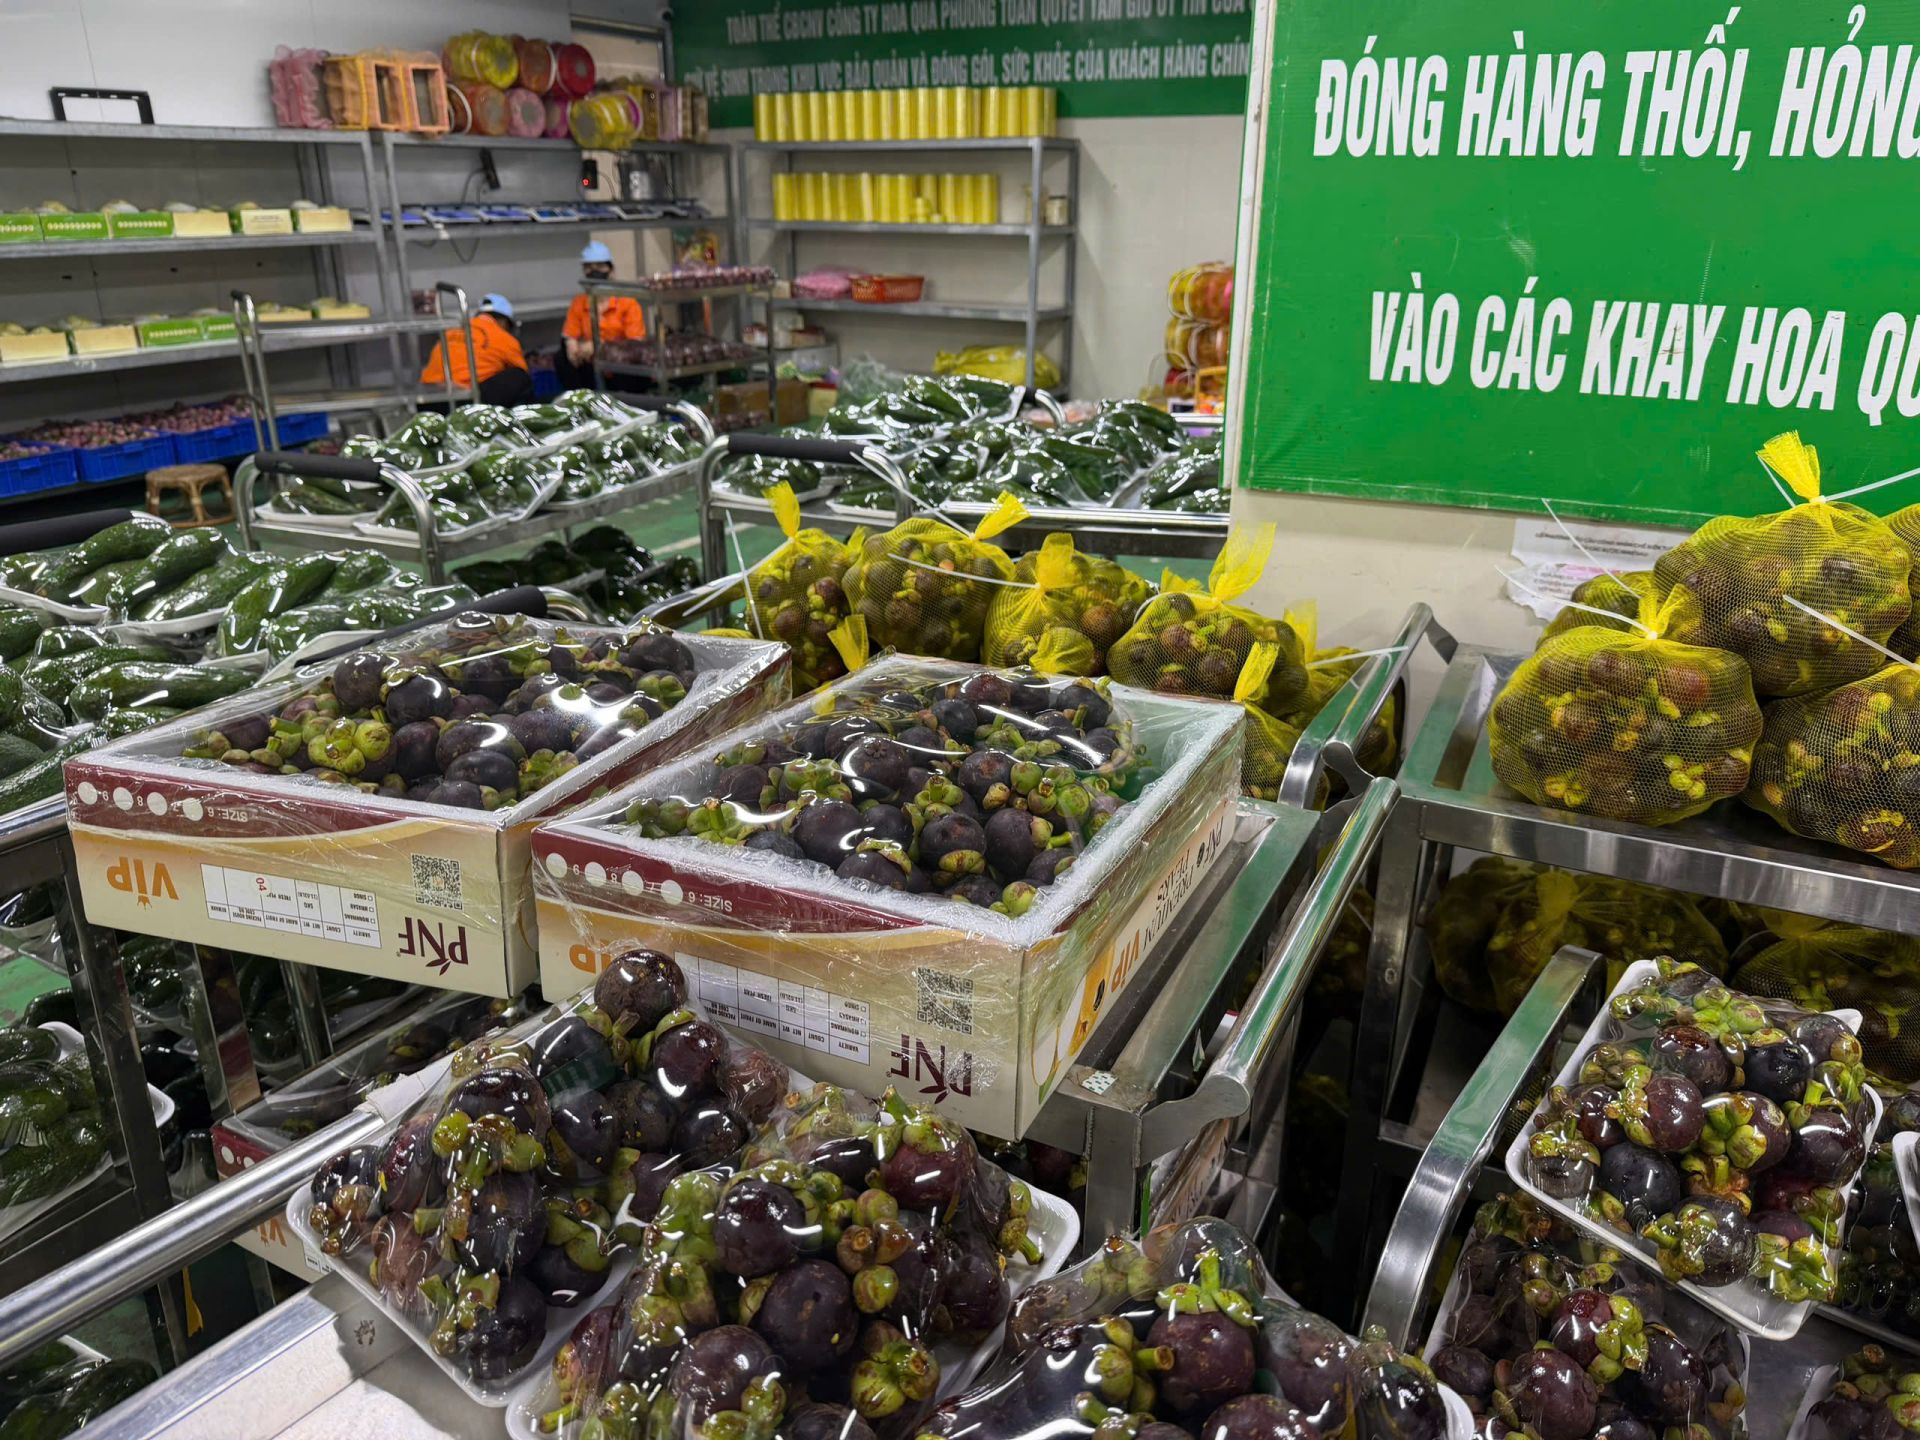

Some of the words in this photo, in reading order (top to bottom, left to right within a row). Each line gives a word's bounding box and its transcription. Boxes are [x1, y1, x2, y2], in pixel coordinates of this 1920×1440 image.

[1074, 39, 1105, 81] CỦA
[1108, 41, 1160, 80] KHÁCH
[1163, 38, 1207, 78] HÀNG
[1313, 35, 1448, 157] ĐÓNG
[1456, 30, 1606, 157] HÀNG
[1618, 6, 1752, 171] THỐI,
[1369, 272, 1460, 385] VÀO
[1470, 276, 1572, 392] CÁC
[1579, 300, 1726, 401] KHAY
[1725, 306, 1846, 410] HOA
[107, 856, 179, 902] VIP
[699, 894, 732, 912] SIZE:
[398, 917, 469, 968] PNF
[890, 1034, 973, 1099] PNF
